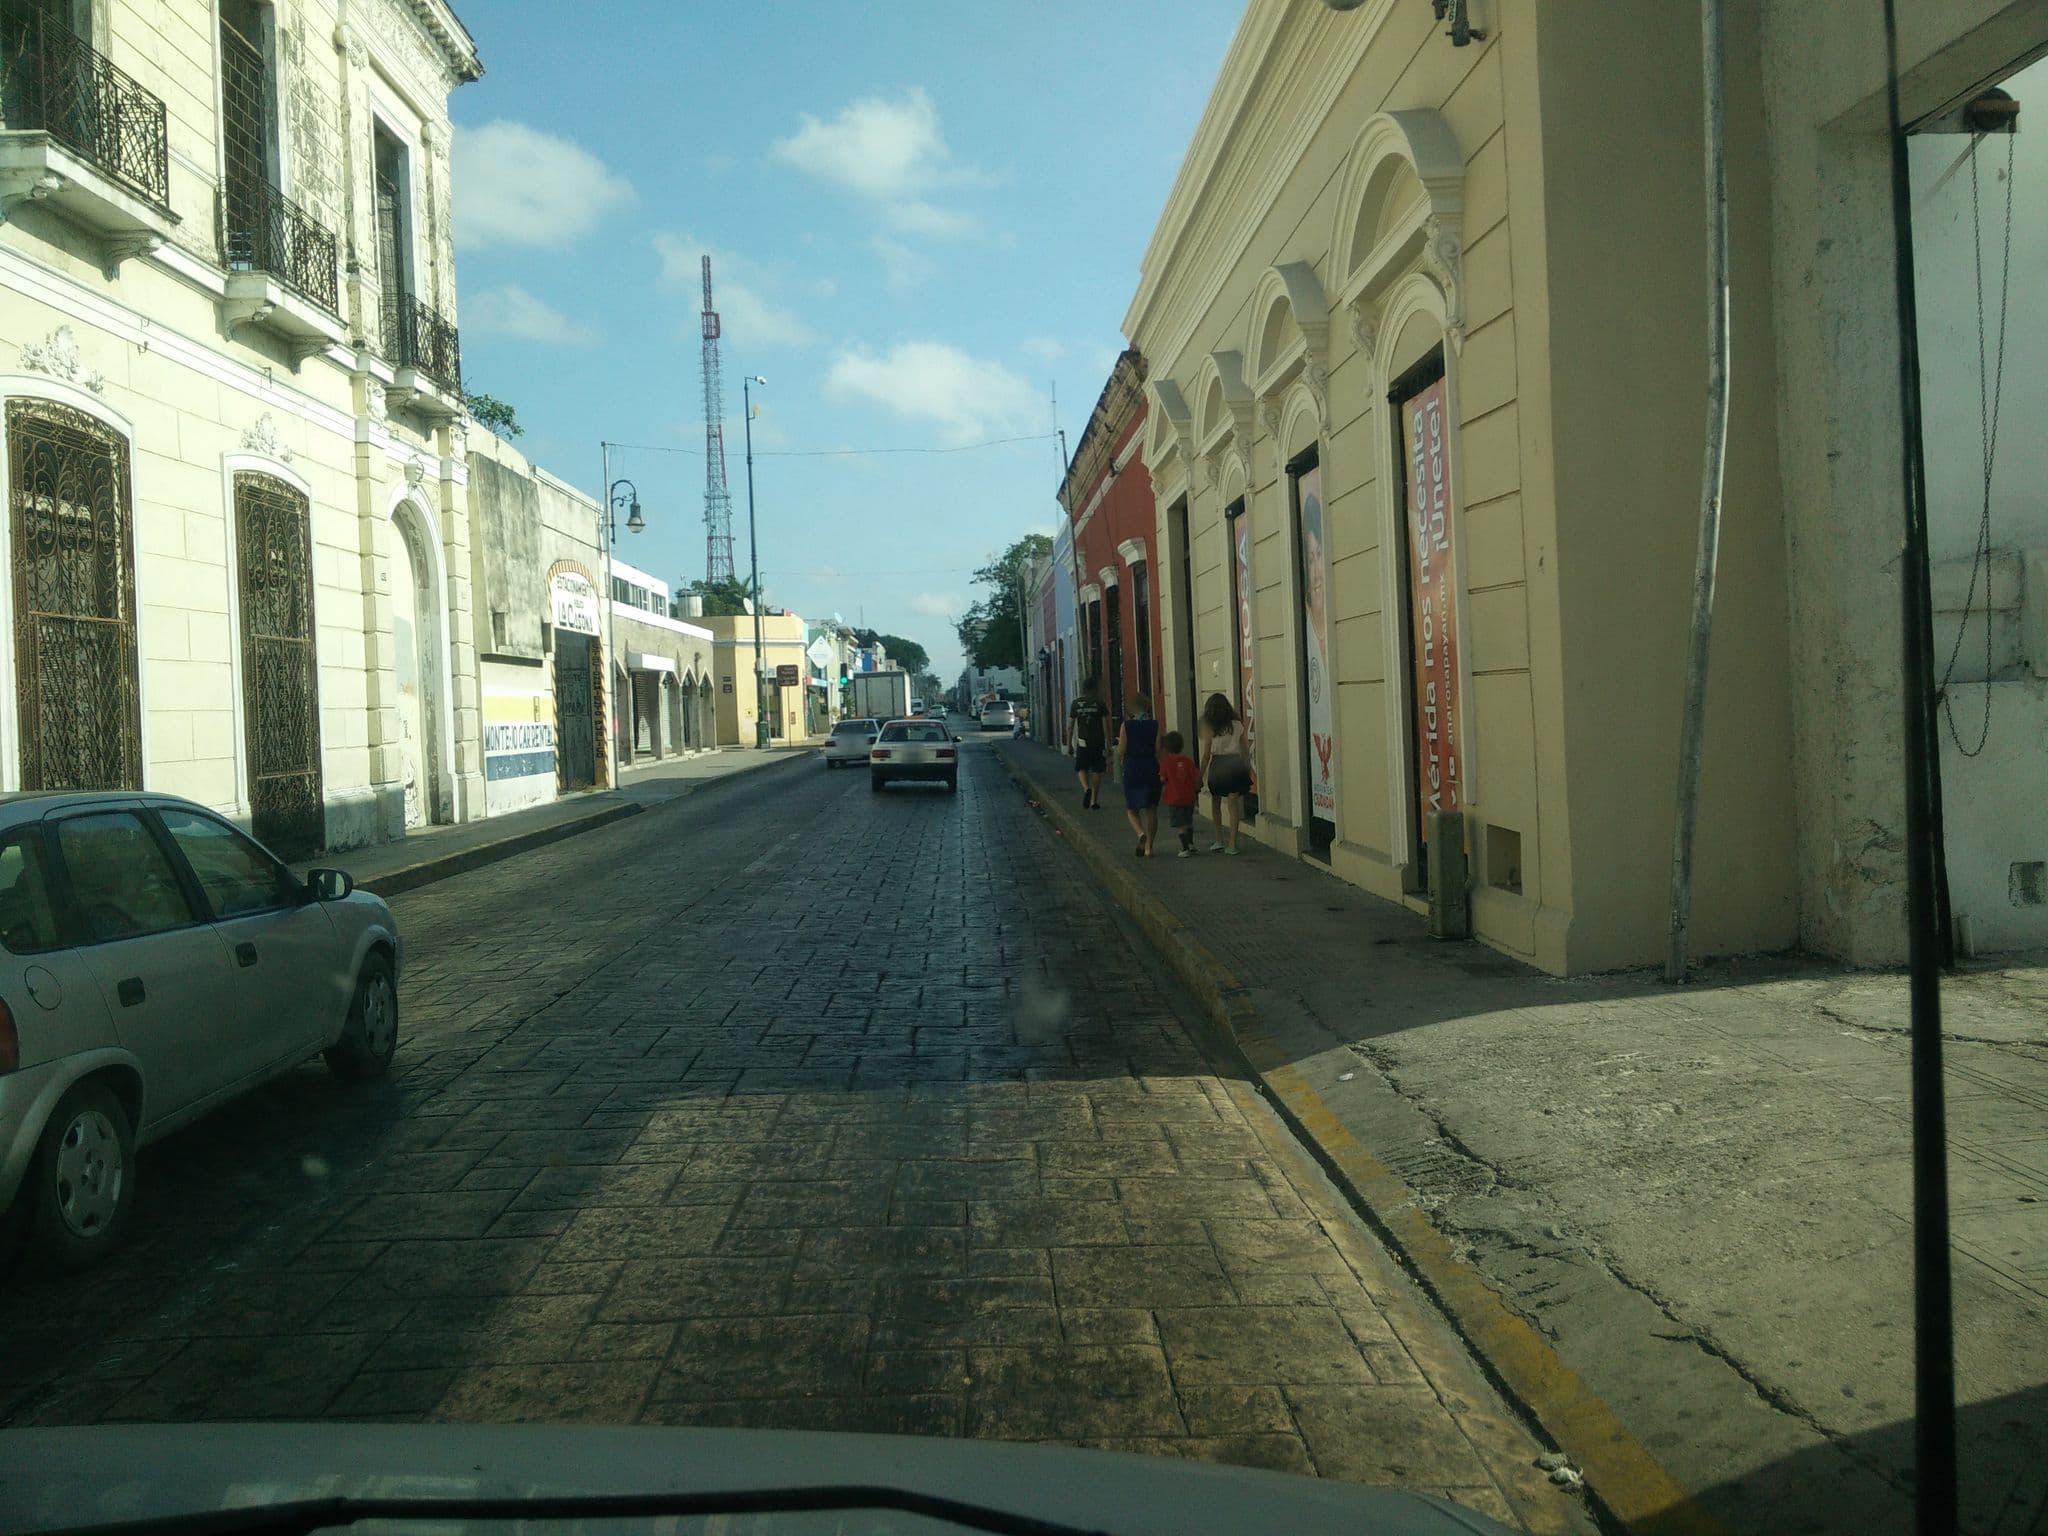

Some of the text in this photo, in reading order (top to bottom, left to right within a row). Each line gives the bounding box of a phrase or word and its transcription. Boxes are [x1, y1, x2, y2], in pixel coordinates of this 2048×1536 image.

[1412, 409, 1431, 584] necesita
[1425, 397, 1449, 551] ¡Únete!
[1238, 532, 1257, 773] ANA ROSA
[1421, 596, 1436, 667] nos
[1438, 573, 1455, 745] anarosapayan.mx
[484, 725, 517, 751] MONTEJO
